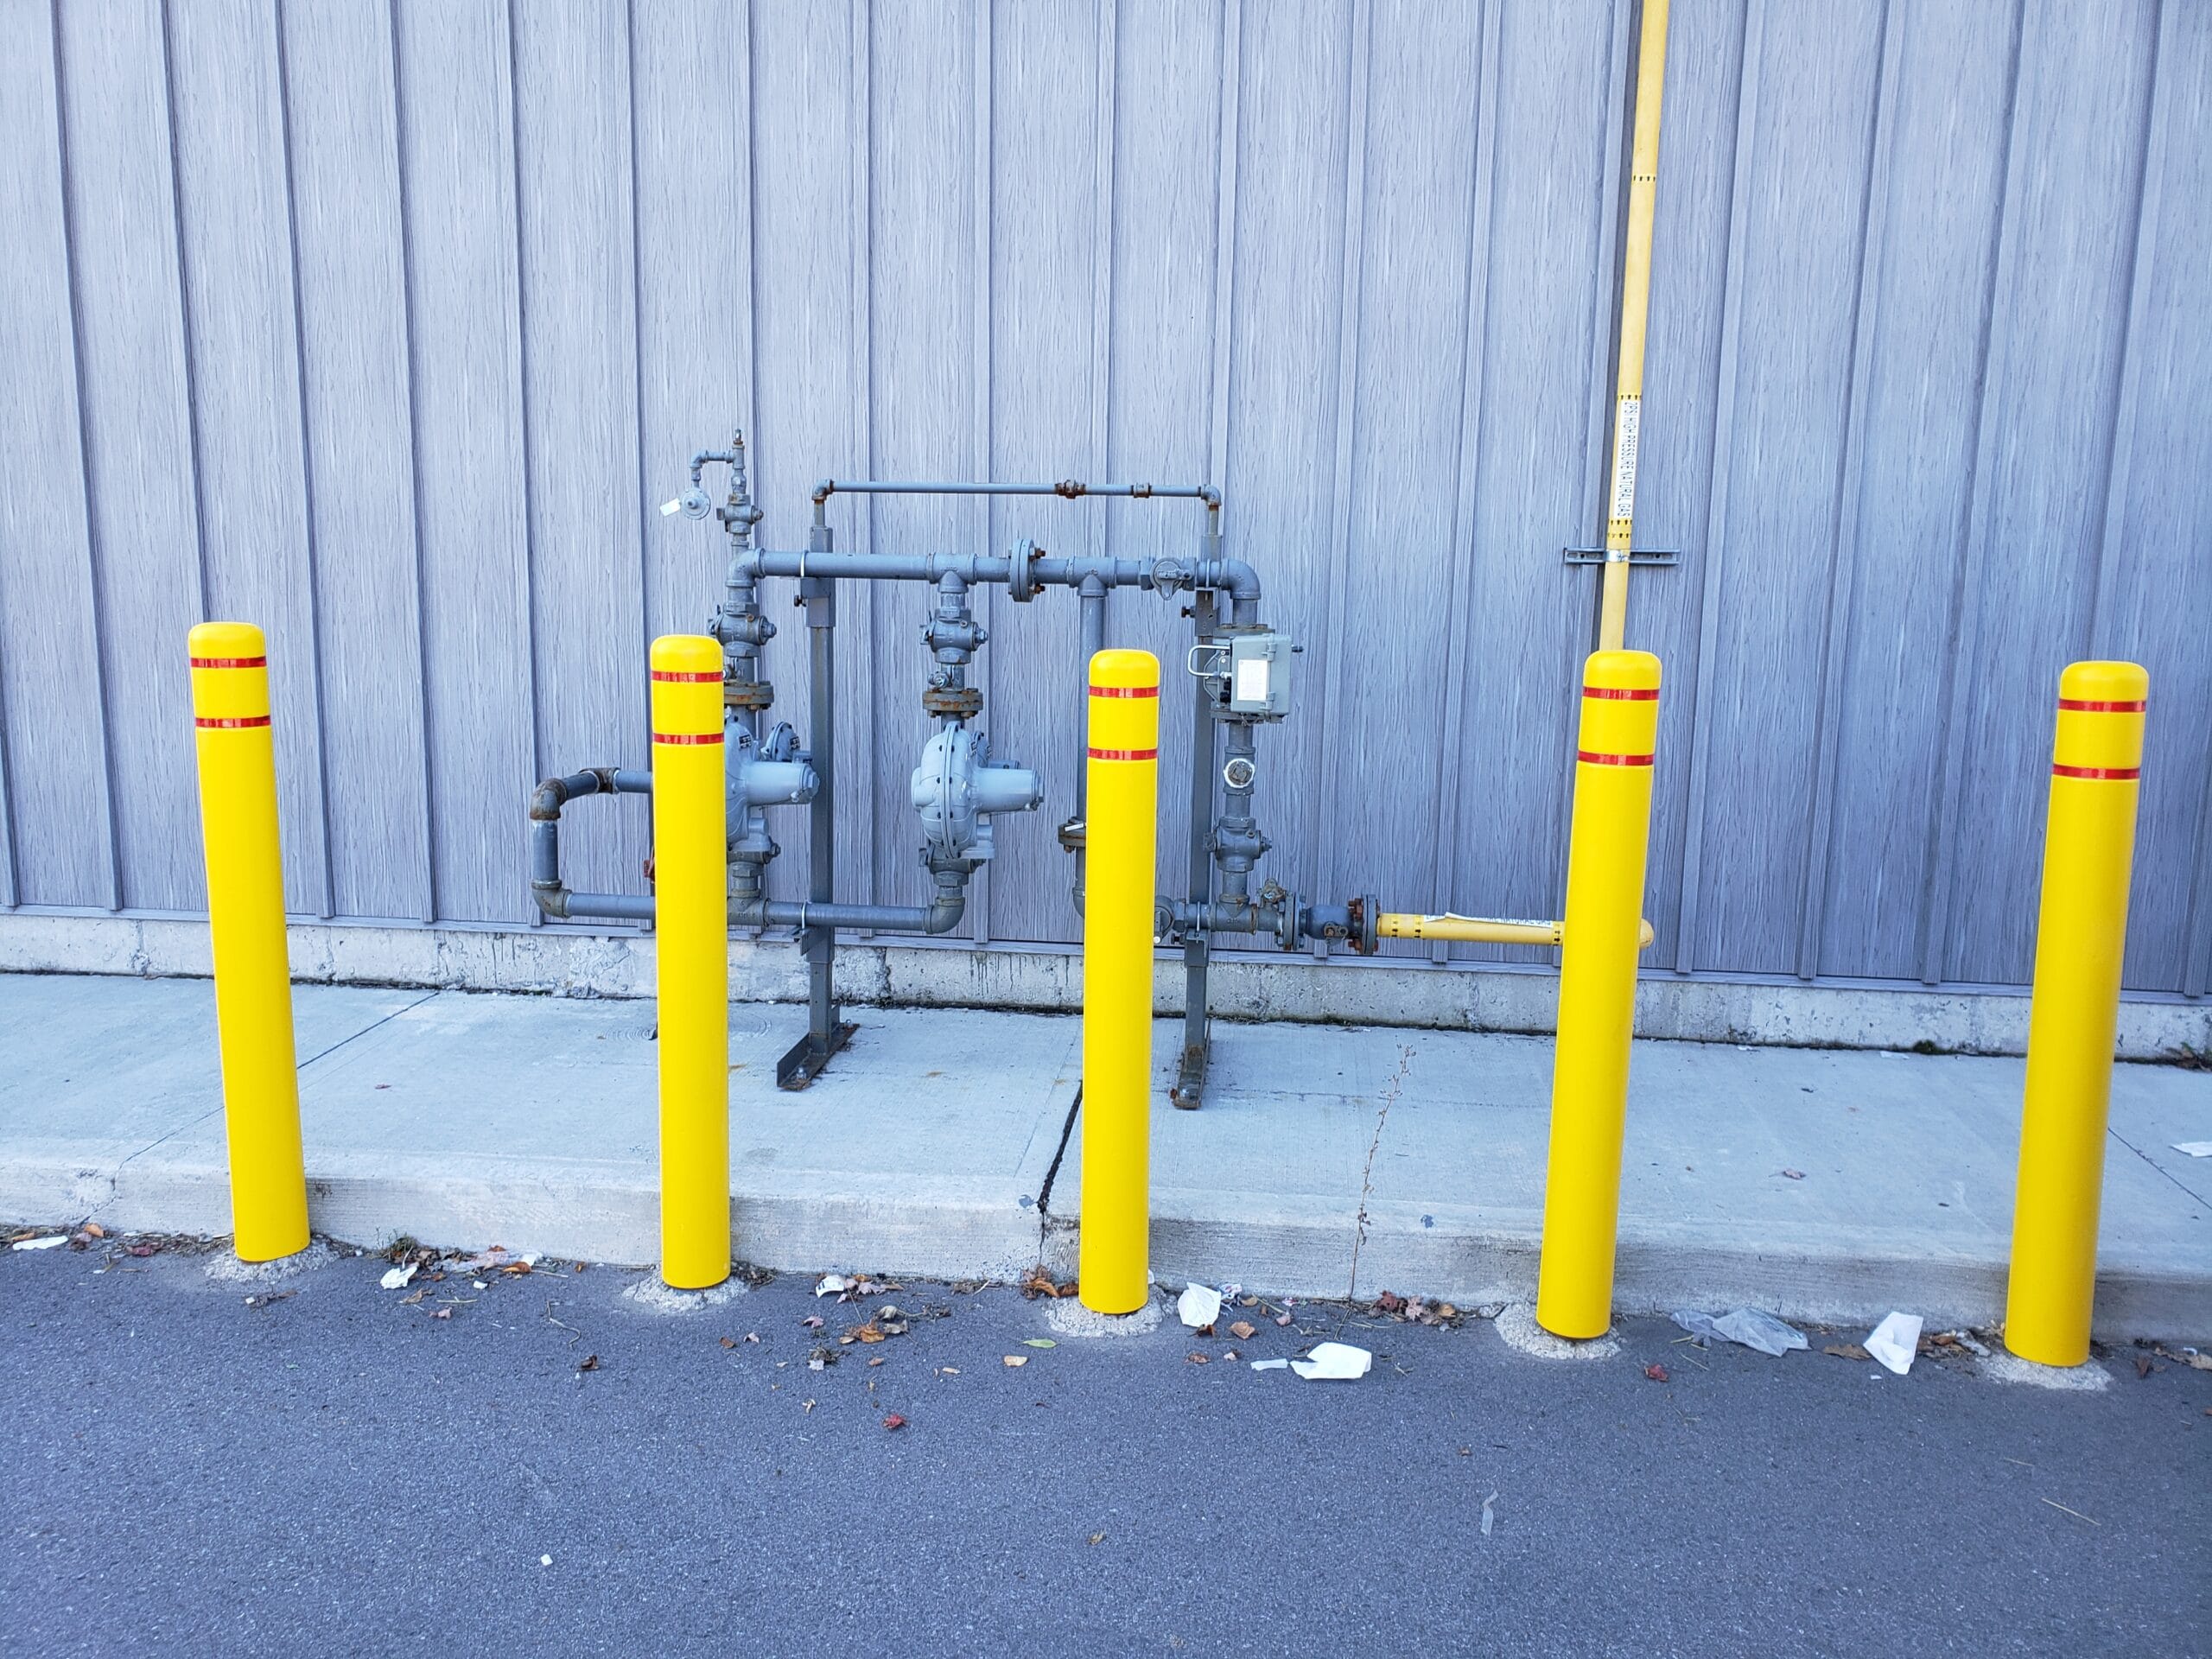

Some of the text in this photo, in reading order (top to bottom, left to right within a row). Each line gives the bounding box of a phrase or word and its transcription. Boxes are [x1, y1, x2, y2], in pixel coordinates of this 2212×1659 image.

[1623, 417, 1637, 433] HIGH
[1620, 435, 1637, 469] PRESSURE
[1618, 471, 1633, 501] NATURAL
[1617, 503, 1630, 517] GAS
